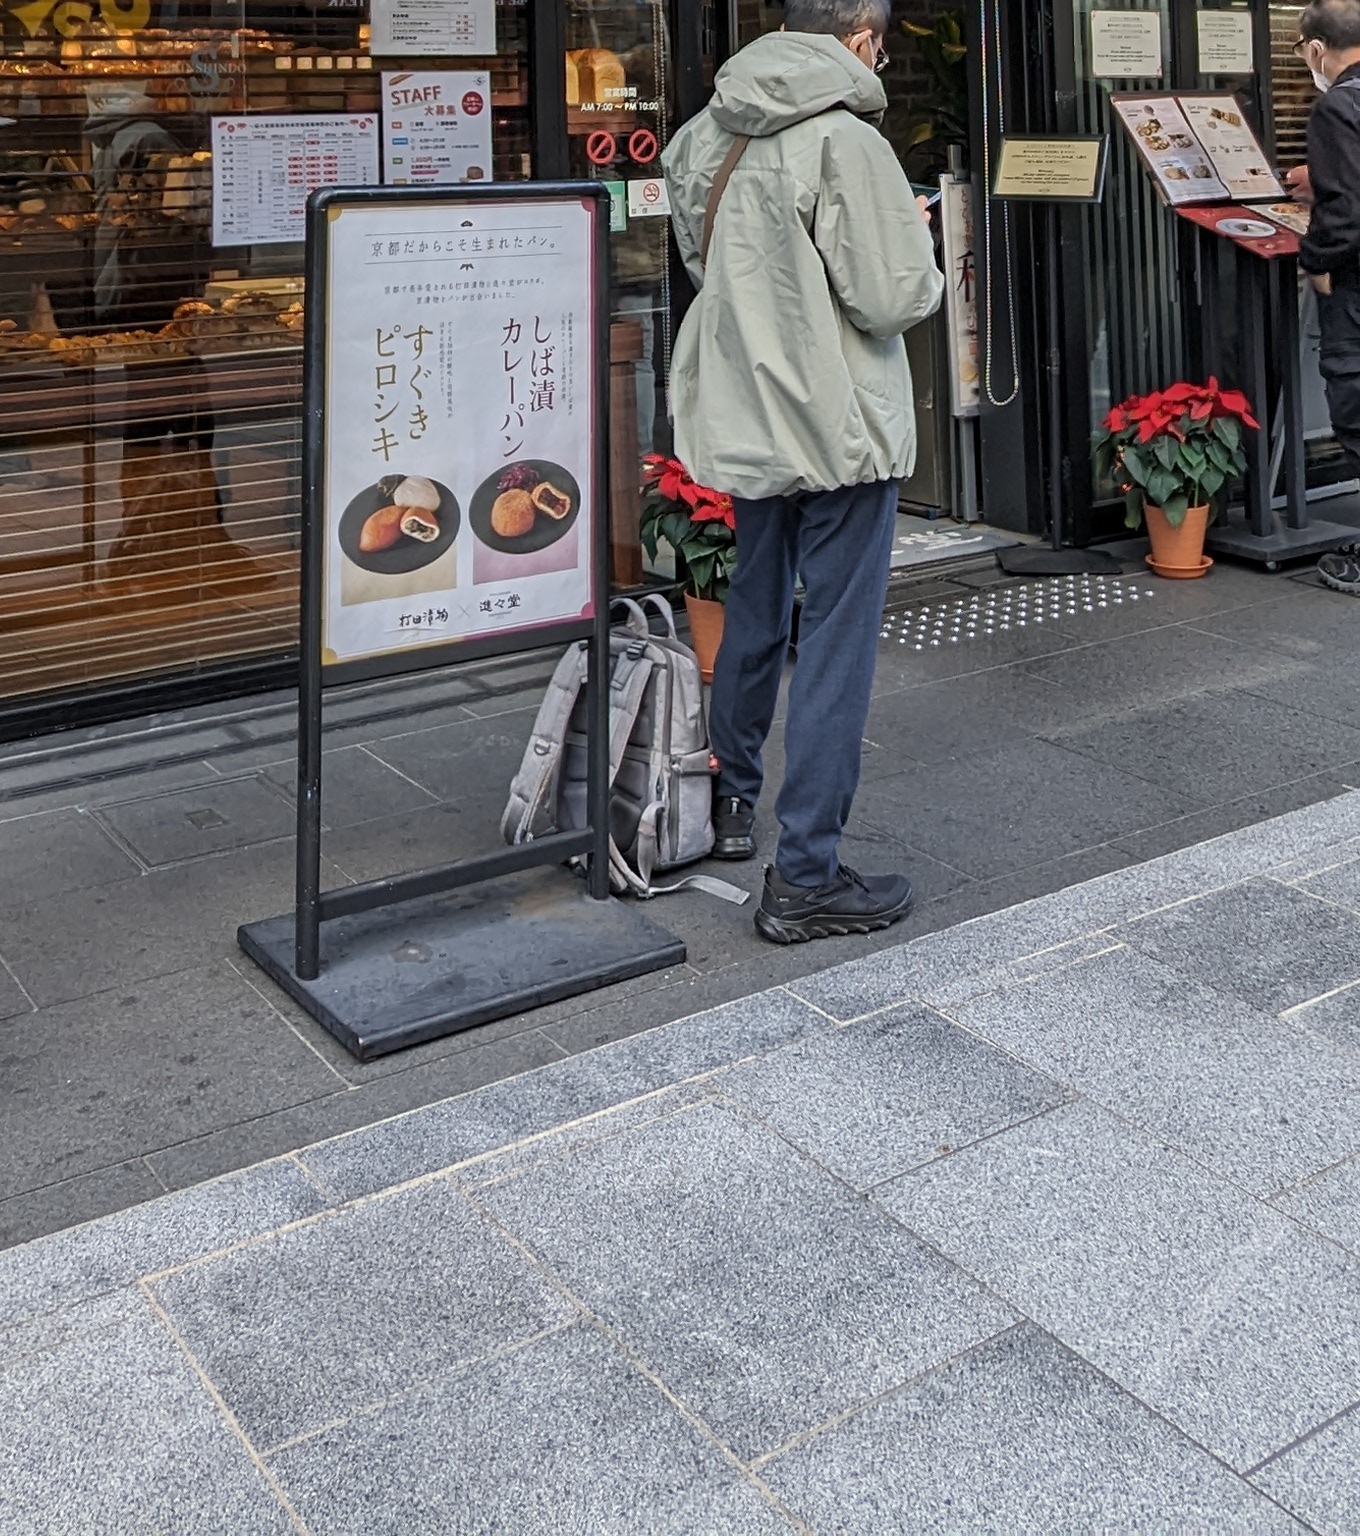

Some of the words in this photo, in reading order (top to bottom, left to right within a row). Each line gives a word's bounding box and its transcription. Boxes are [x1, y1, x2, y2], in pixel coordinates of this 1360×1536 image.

[391, 85, 442, 106] STAFF
[581, 103, 595, 112] AM
[596, 102, 613, 111] 7:00
[624, 102, 638, 111] PM
[639, 101, 659, 111] 10:00
[424, 105, 456, 116] 大募集
[371, 235, 555, 258] 京都だからこそ生まれたパン。
[529, 315, 556, 412] しば漬
[372, 324, 402, 461] ピロシキ
[403, 324, 434, 440] すぐき
[500, 317, 525, 458] カレーパン
[479, 593, 521, 613] 進々堂
